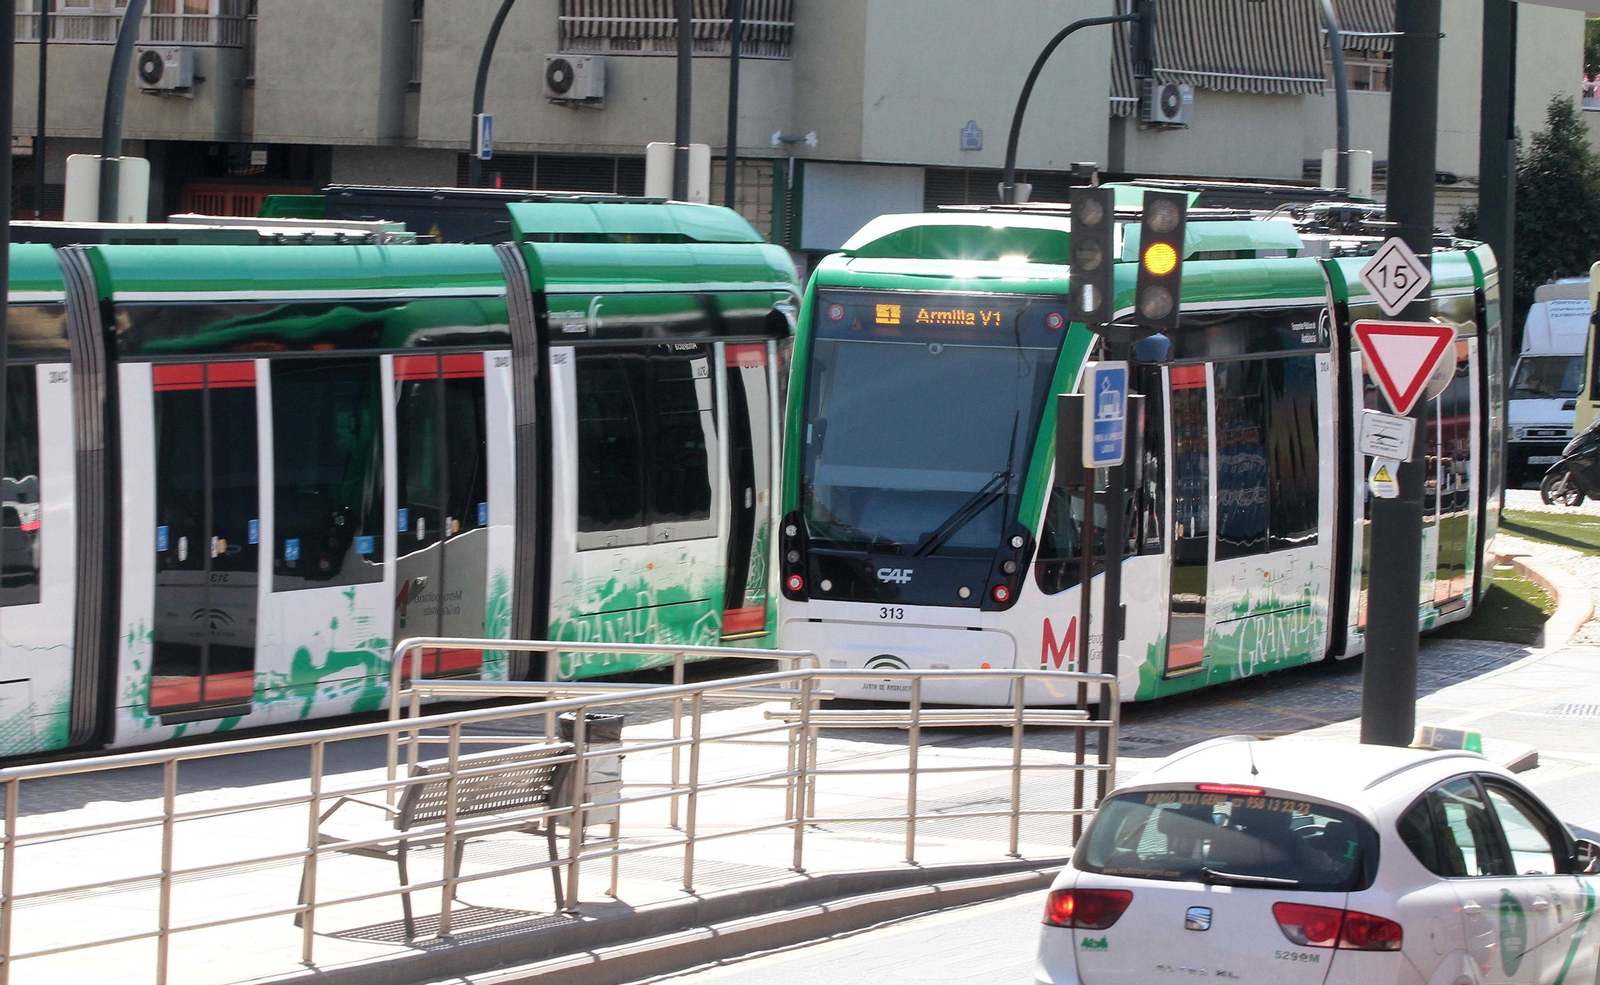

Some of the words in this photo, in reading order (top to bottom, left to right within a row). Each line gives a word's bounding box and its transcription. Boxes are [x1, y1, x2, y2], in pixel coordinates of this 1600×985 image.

[1378, 264, 1408, 289] 15
[916, 308, 975, 326] Armilla
[979, 309, 1001, 326] V1
[876, 567, 914, 584] CAF
[879, 606, 905, 620] 313
[1040, 615, 1077, 672] M
[1238, 586, 1321, 678] GRANADA
[1145, 793, 1176, 805] RADIO
[1178, 793, 1200, 806] TAXI
[1246, 796, 1265, 810] 958
[1266, 798, 1280, 812] 13
[1280, 800, 1297, 814] 23
[1297, 802, 1312, 816] 23
